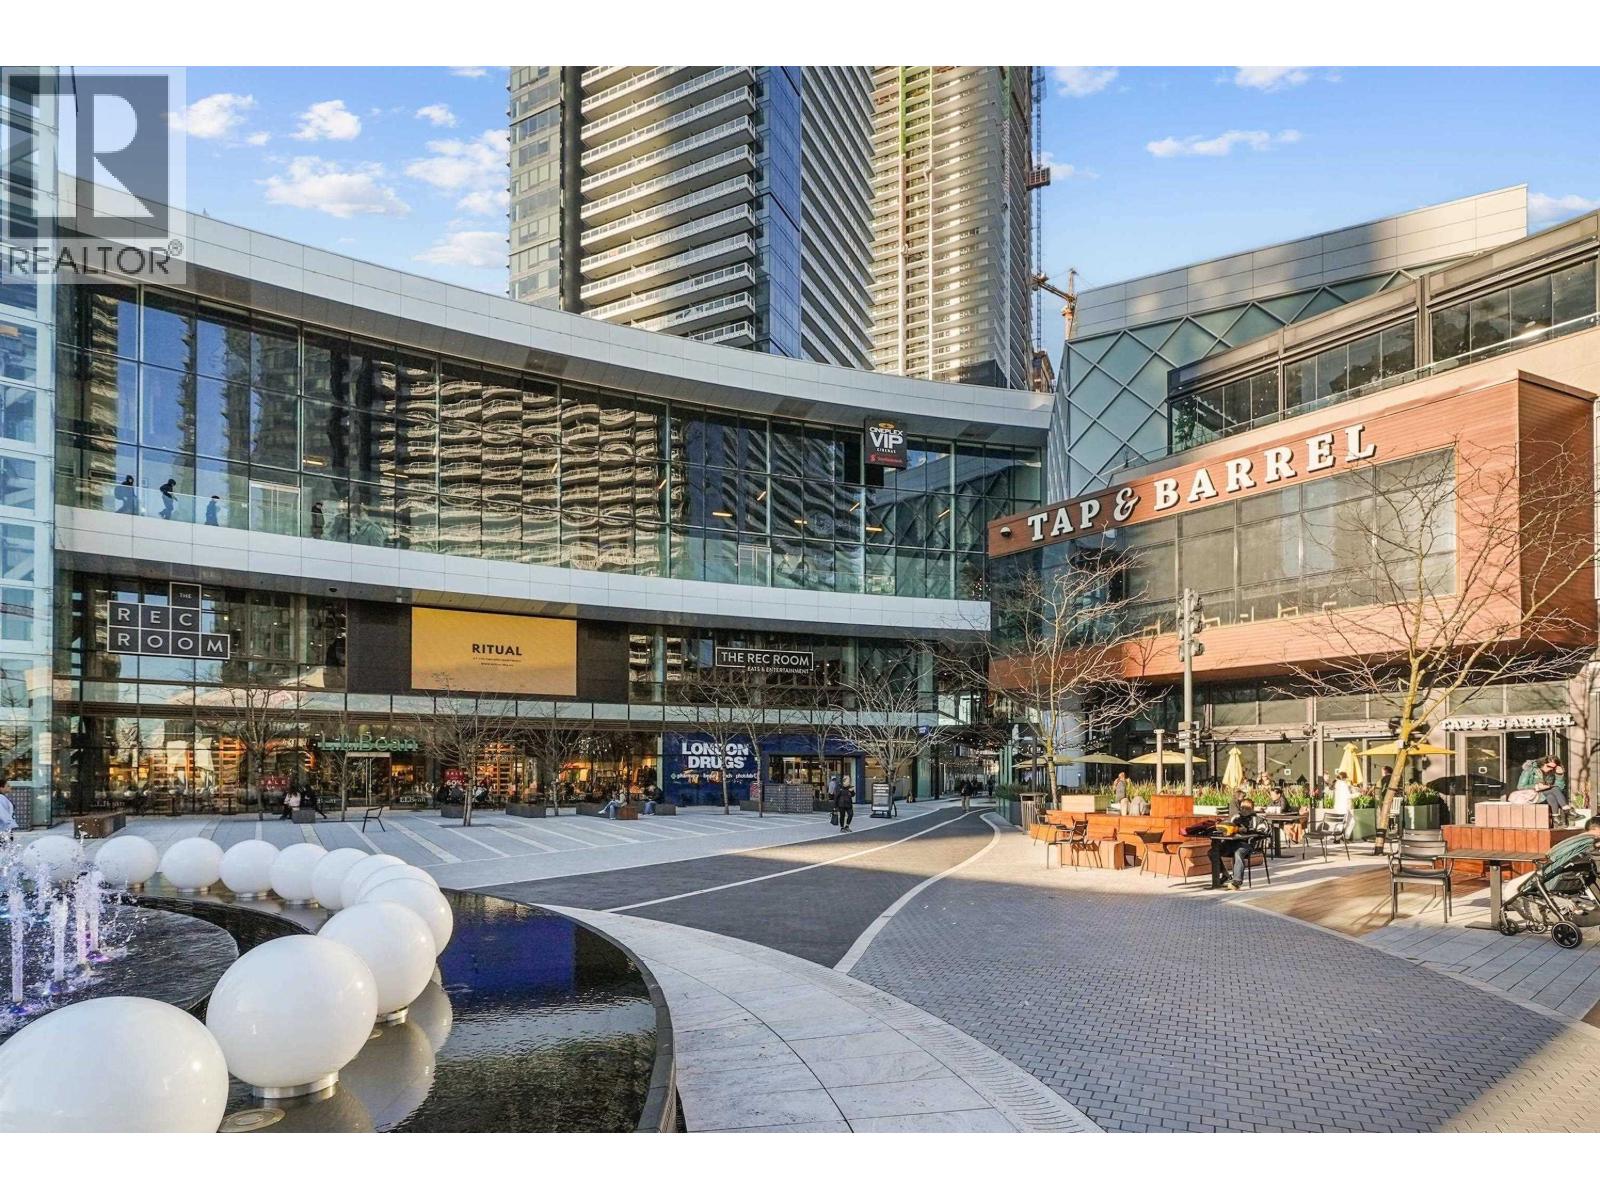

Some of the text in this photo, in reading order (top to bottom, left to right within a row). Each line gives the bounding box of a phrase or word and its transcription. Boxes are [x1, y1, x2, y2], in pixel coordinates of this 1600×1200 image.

[869, 431, 904, 449] VIP
[1027, 424, 1376, 541] TAP & BARREL
[117, 607, 193, 626] REC
[117, 632, 223, 653] ROOM
[472, 643, 522, 655] RITUAL
[721, 651, 810, 666] THE REC ROOM
[1440, 719, 1475, 731] TAP
[1497, 713, 1577, 729] BARREL
